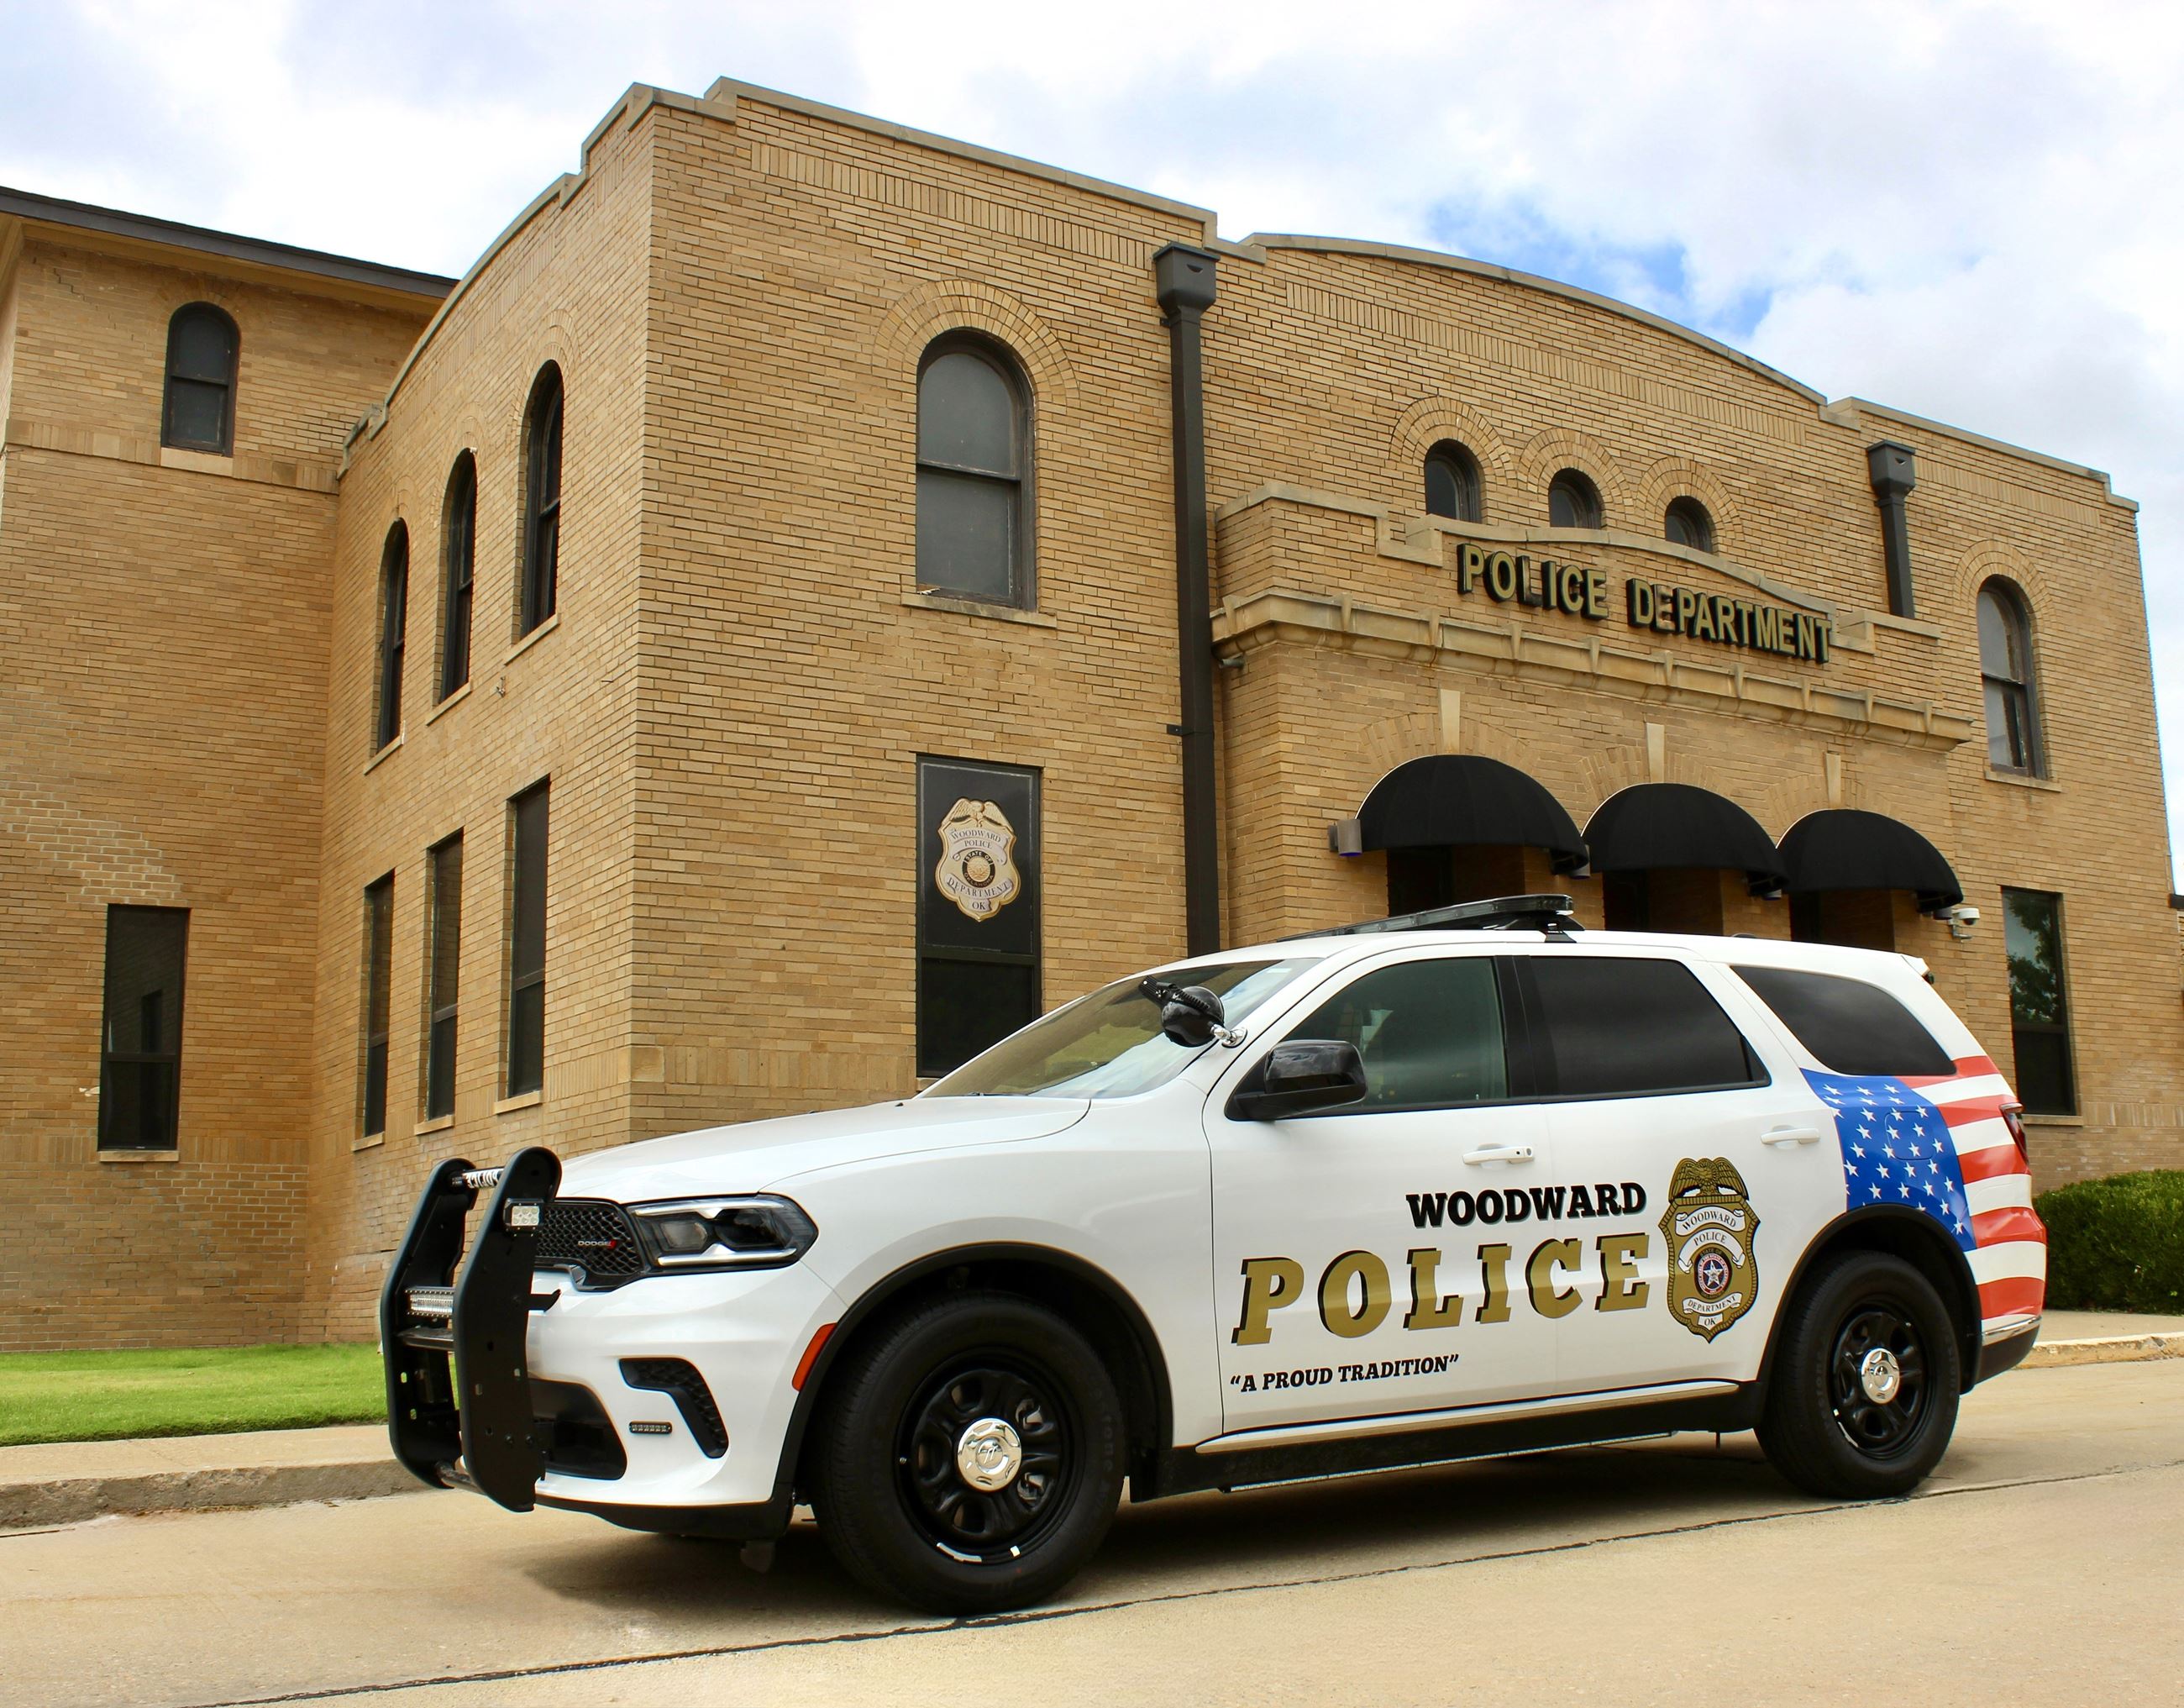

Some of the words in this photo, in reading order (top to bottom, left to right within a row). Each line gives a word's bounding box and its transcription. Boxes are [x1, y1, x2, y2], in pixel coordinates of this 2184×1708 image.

[1457, 543, 1609, 620] POLICE
[1626, 577, 1832, 664] DEPARTMENT
[951, 828, 1001, 843] WOODWARD
[963, 839, 993, 849] POLICE
[965, 851, 983, 861] STATE
[984, 854, 994, 864] OF
[948, 876, 1009, 897] DEPARTMENT
[963, 872, 994, 887] OKLAHOMA
[972, 901, 986, 910] OK
[1405, 1181, 1647, 1228] WOODWARD
[1682, 1211, 1736, 1230] WOODWARD
[1693, 1232, 1727, 1246] POLICE
[1231, 1232, 1650, 1346] POLICE
[1688, 1295, 1736, 1312] DEPARTMENT
[1704, 1316, 1718, 1327] OK
[1263, 1367, 1333, 1391] PROUD
